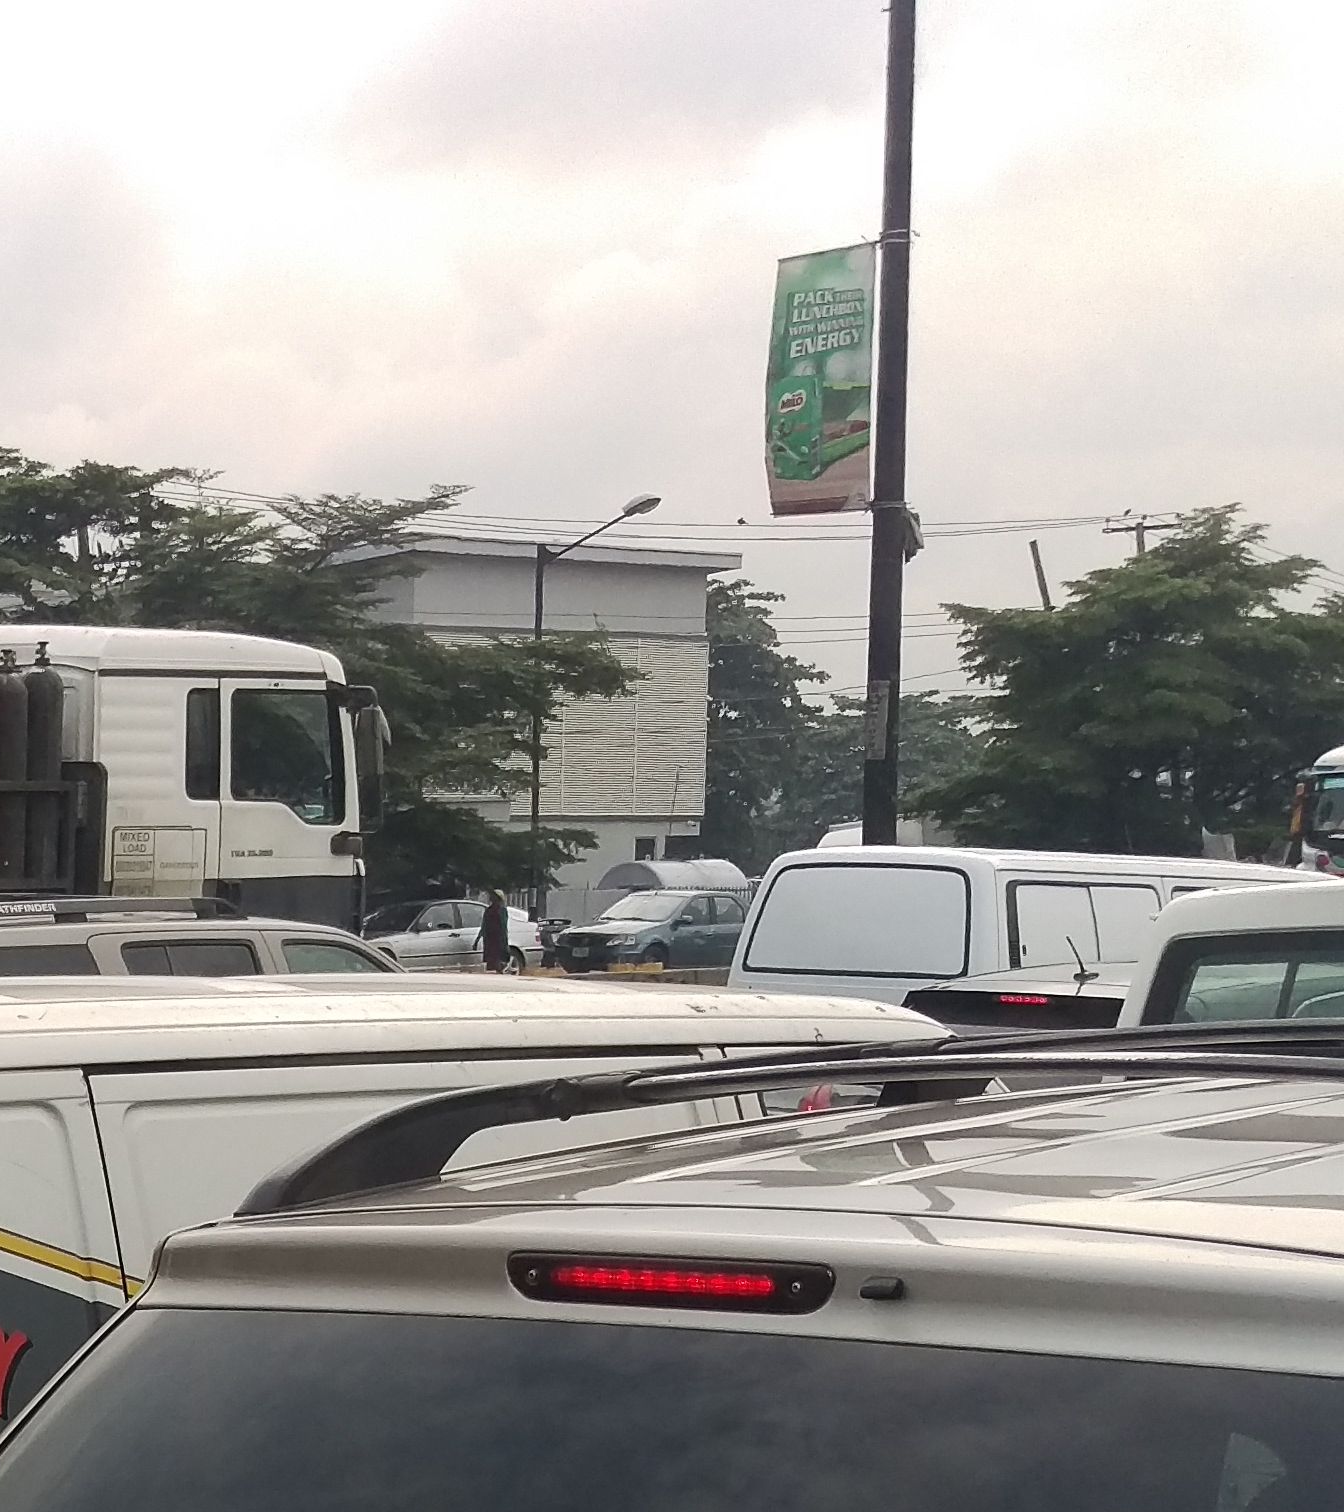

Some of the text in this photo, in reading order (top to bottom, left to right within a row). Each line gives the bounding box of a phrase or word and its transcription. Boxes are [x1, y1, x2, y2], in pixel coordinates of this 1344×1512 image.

[793, 291, 833, 306] PACK
[790, 329, 860, 358] ENERGY
[120, 831, 150, 842] MIXED
[123, 843, 147, 853] LOAD
